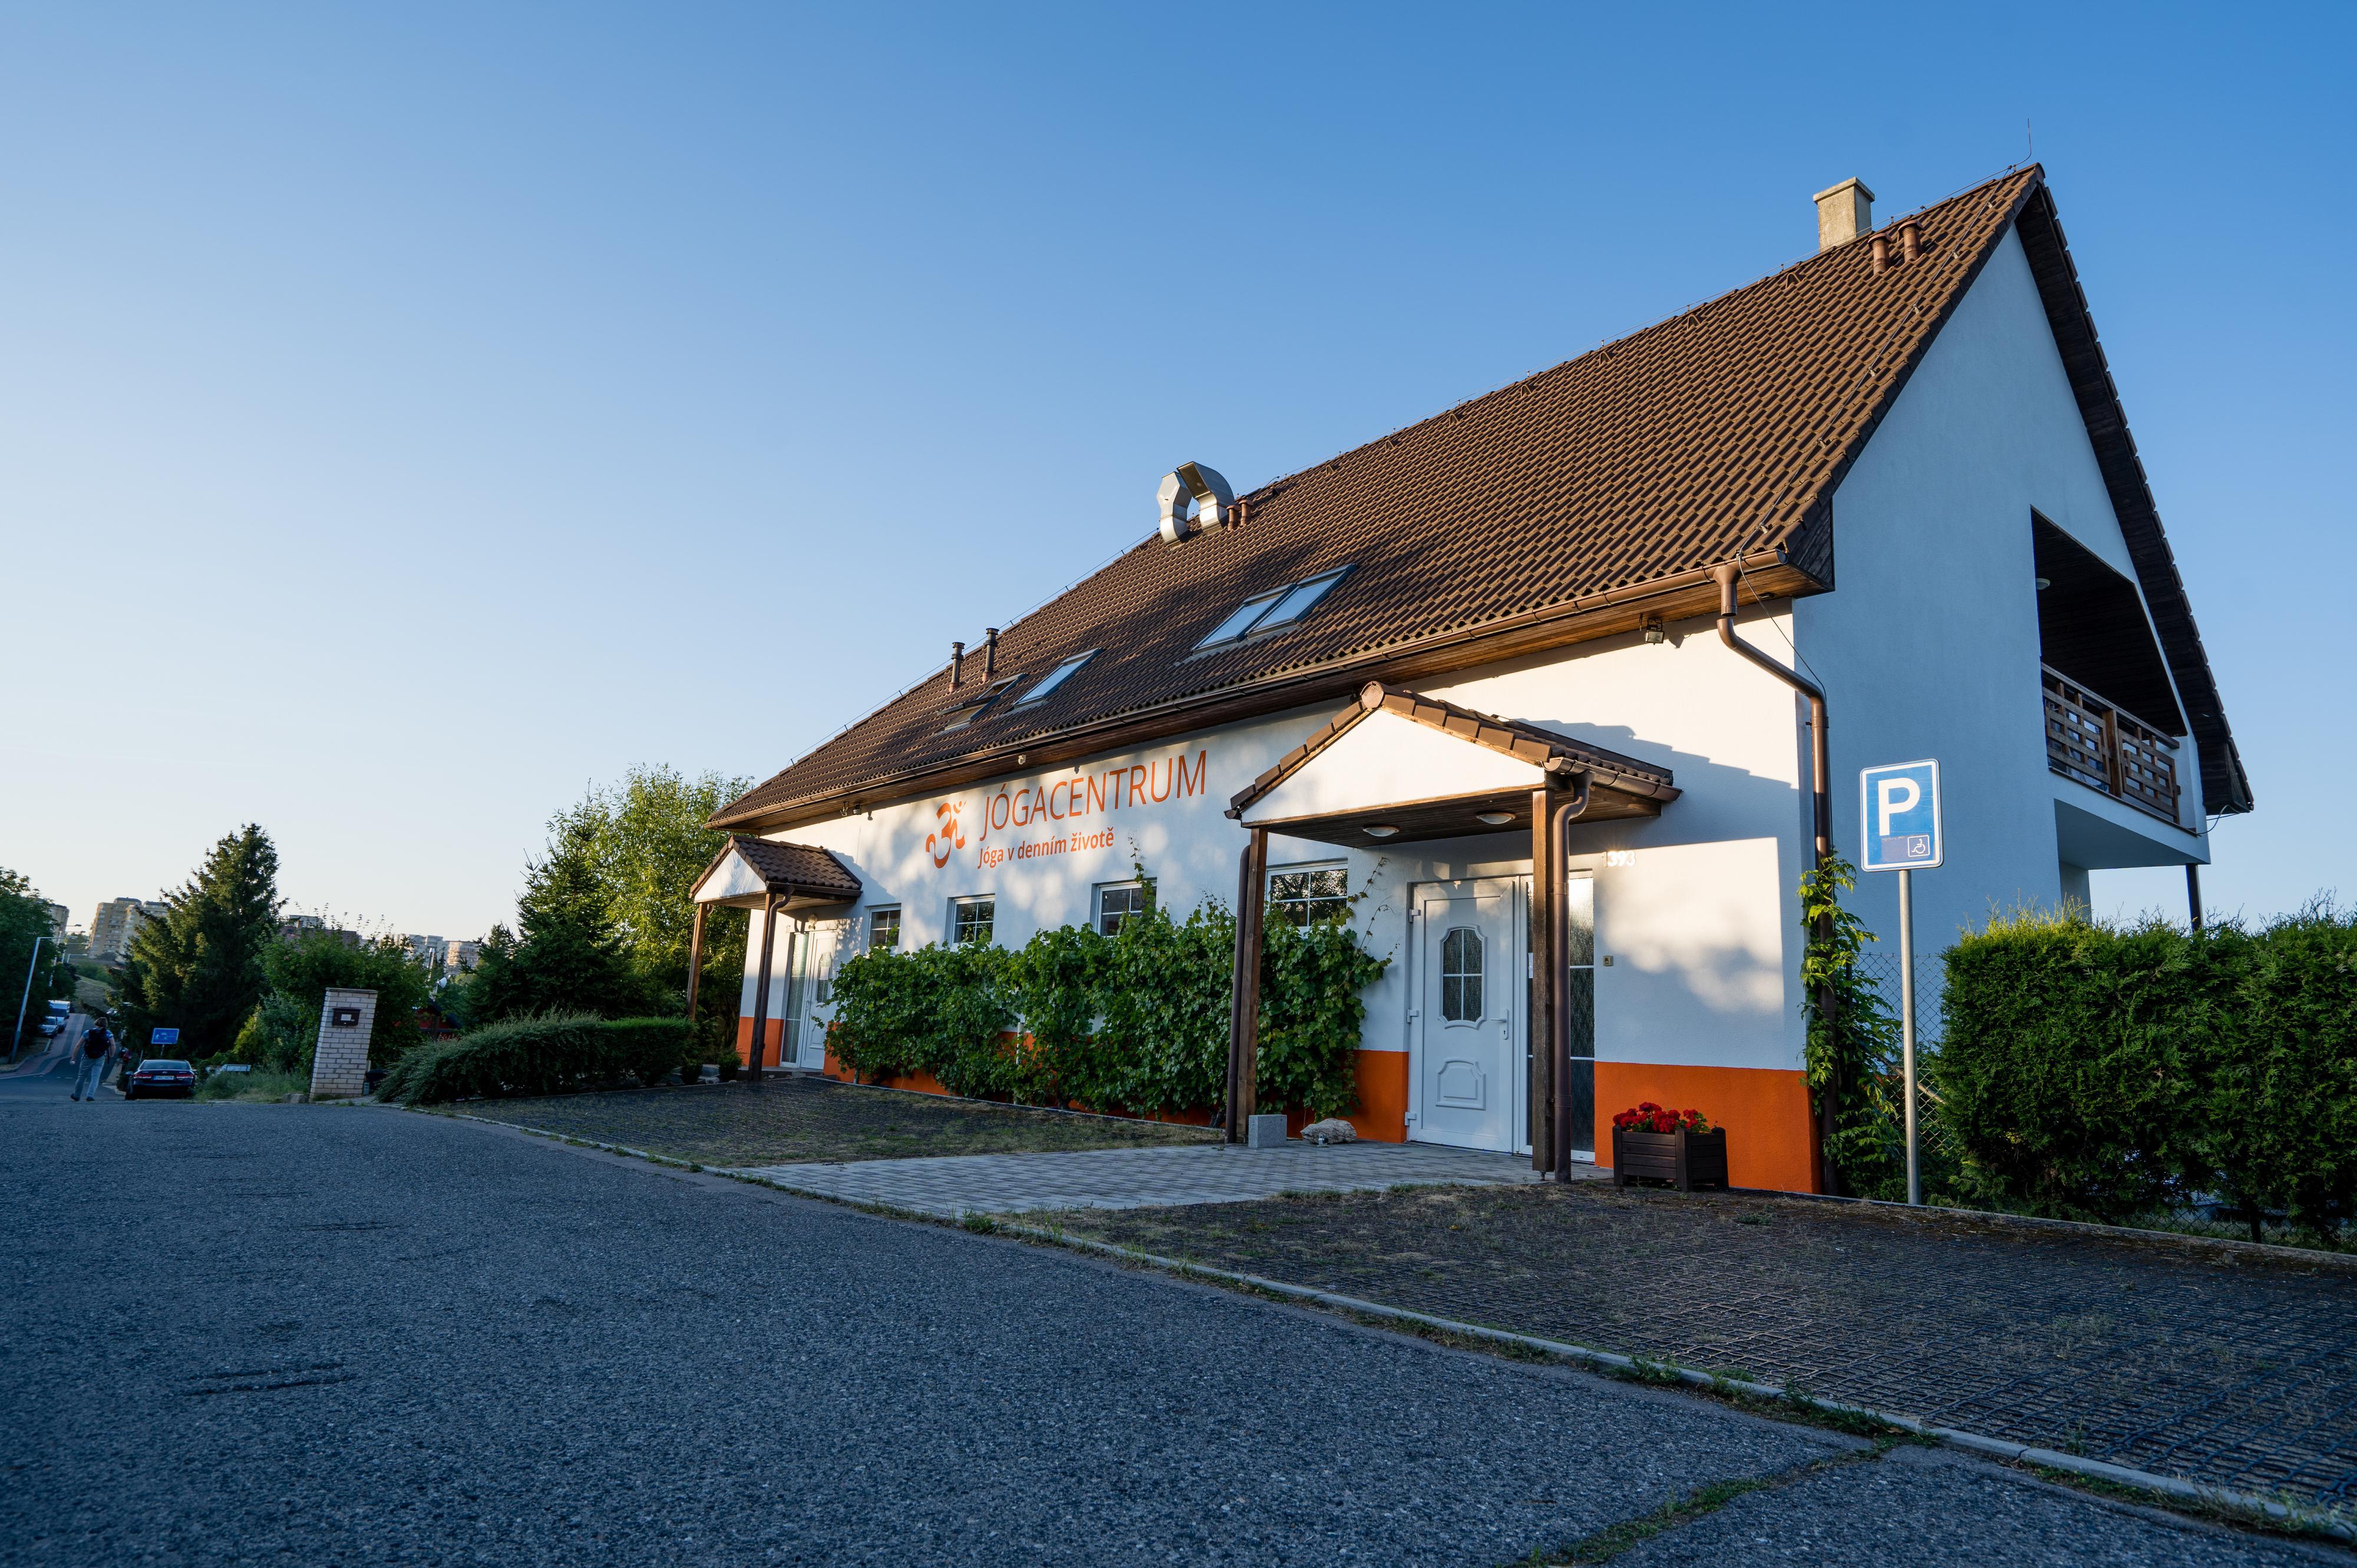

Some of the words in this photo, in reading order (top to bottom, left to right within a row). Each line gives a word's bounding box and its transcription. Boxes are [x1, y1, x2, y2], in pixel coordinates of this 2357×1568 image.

[979, 750, 1206, 841] JÓGACENTRUM
[1877, 777, 1920, 836] P
[978, 847, 1004, 869] Jóga
[1008, 847, 1015, 861] v
[1018, 836, 1067, 860] denním
[1069, 826, 1115, 853] životě
